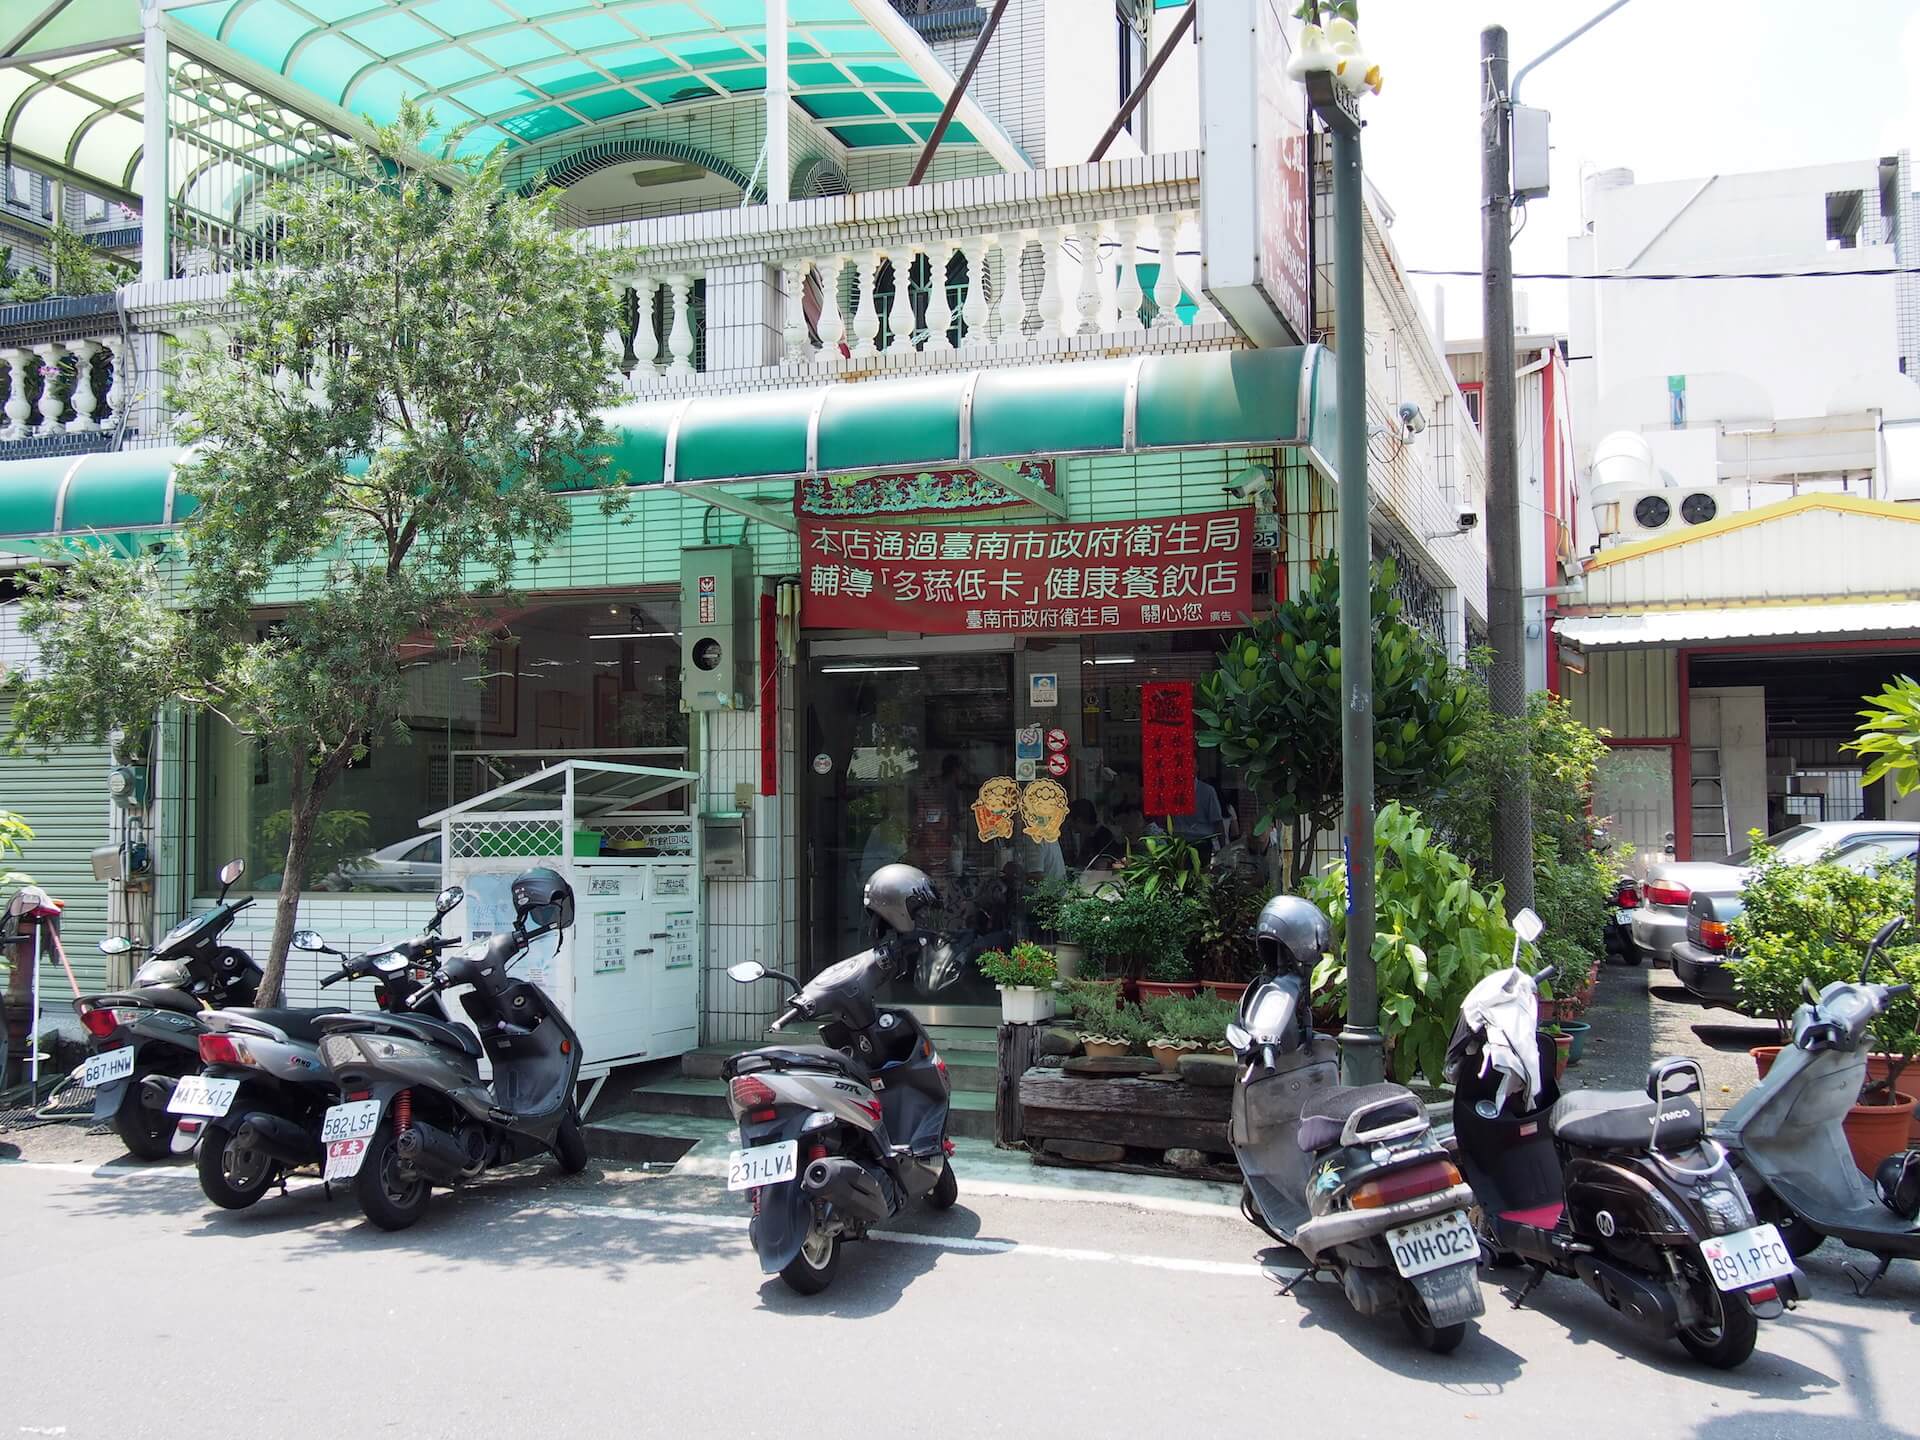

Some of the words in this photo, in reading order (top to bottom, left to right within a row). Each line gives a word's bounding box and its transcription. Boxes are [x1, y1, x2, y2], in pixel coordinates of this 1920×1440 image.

[810, 516, 1240, 561] 本店通過臺南市政府衛生局
[1253, 532, 1276, 547] 25
[810, 560, 1238, 605] 輔導「多蔬低卡」健康餐飲店
[965, 605, 1120, 629] 臺南市政府衛生局
[1140, 602, 1203, 625] 關心您
[1210, 610, 1232, 622] 廣告
